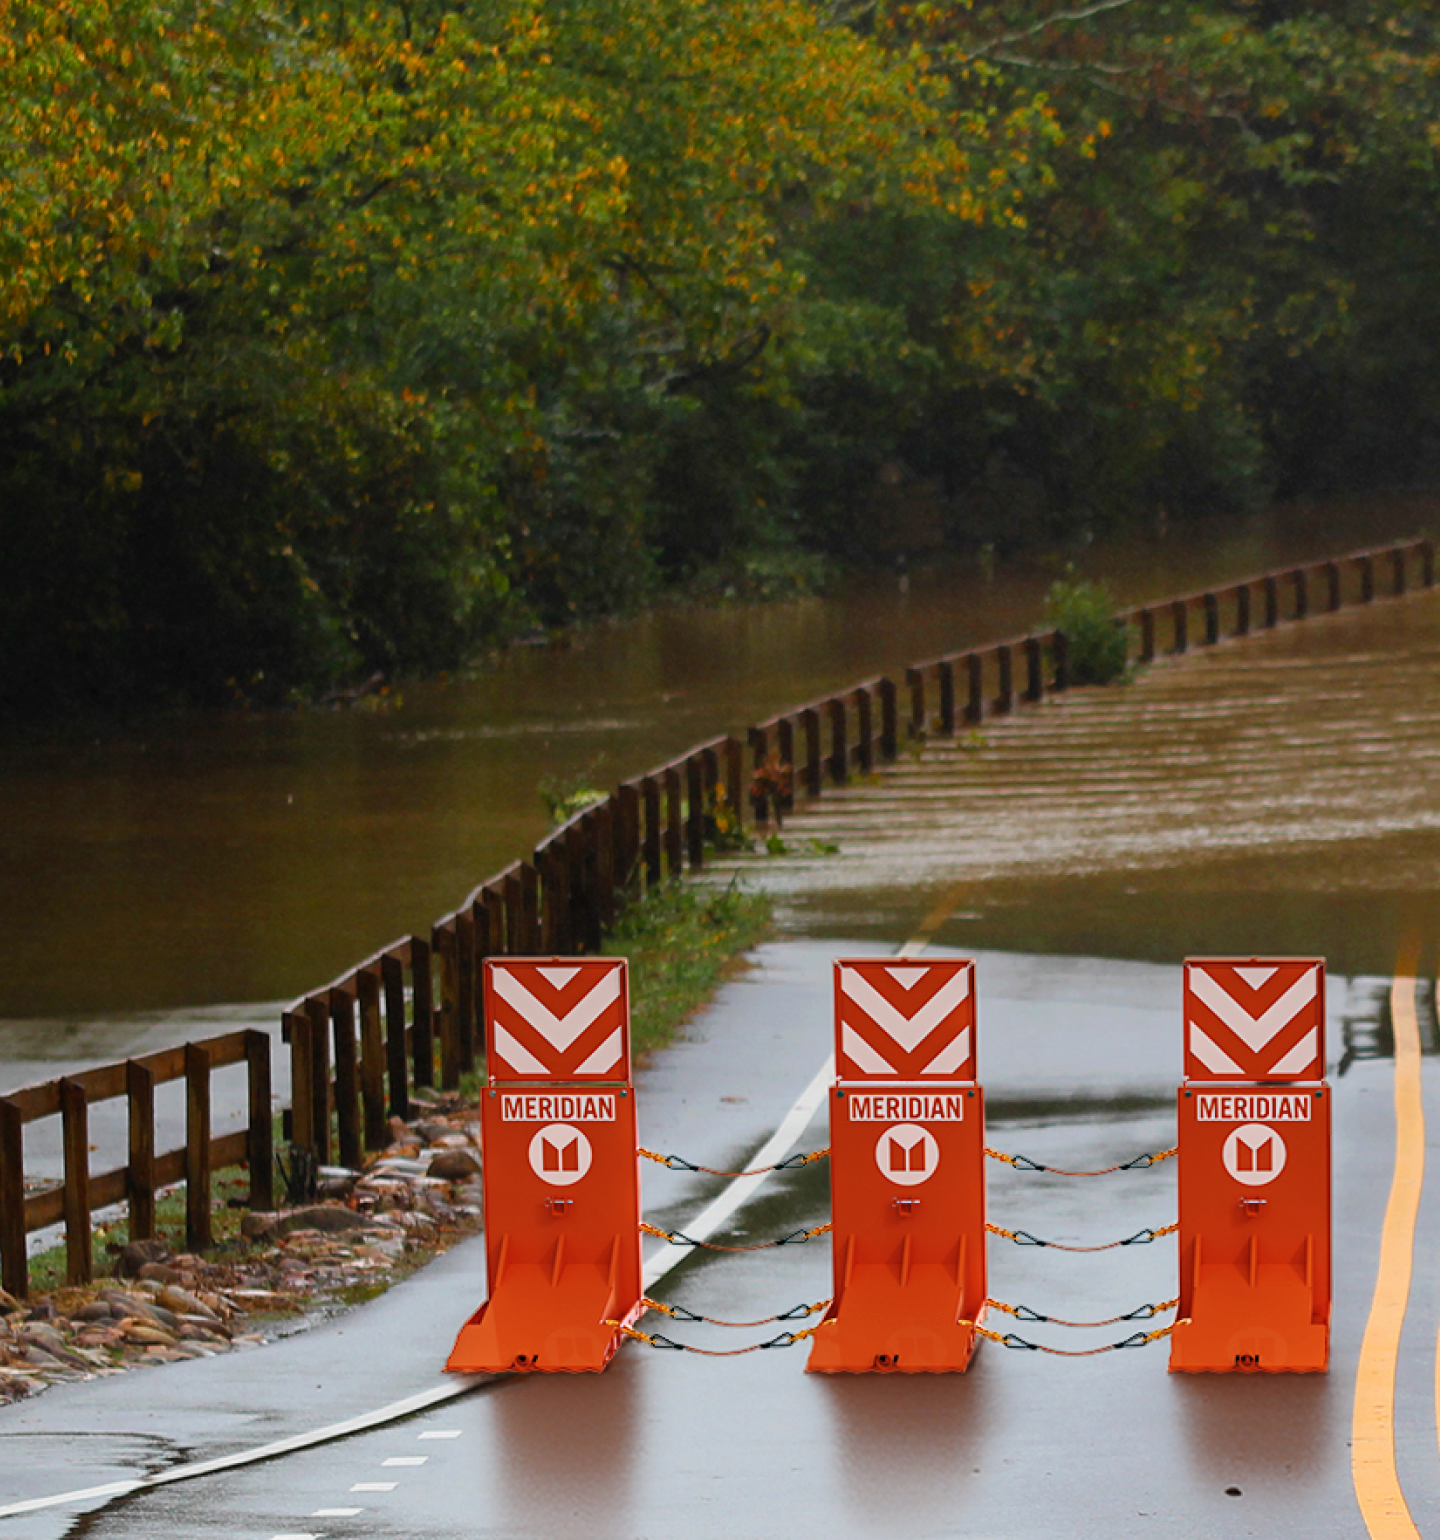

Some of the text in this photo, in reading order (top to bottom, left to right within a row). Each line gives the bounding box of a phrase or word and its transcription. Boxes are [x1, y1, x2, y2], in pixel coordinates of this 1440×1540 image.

[504, 1097, 614, 1119] MERIDIAN
[851, 1097, 961, 1119] MERIDIAN
[1200, 1097, 1309, 1119] MERIDIAN
